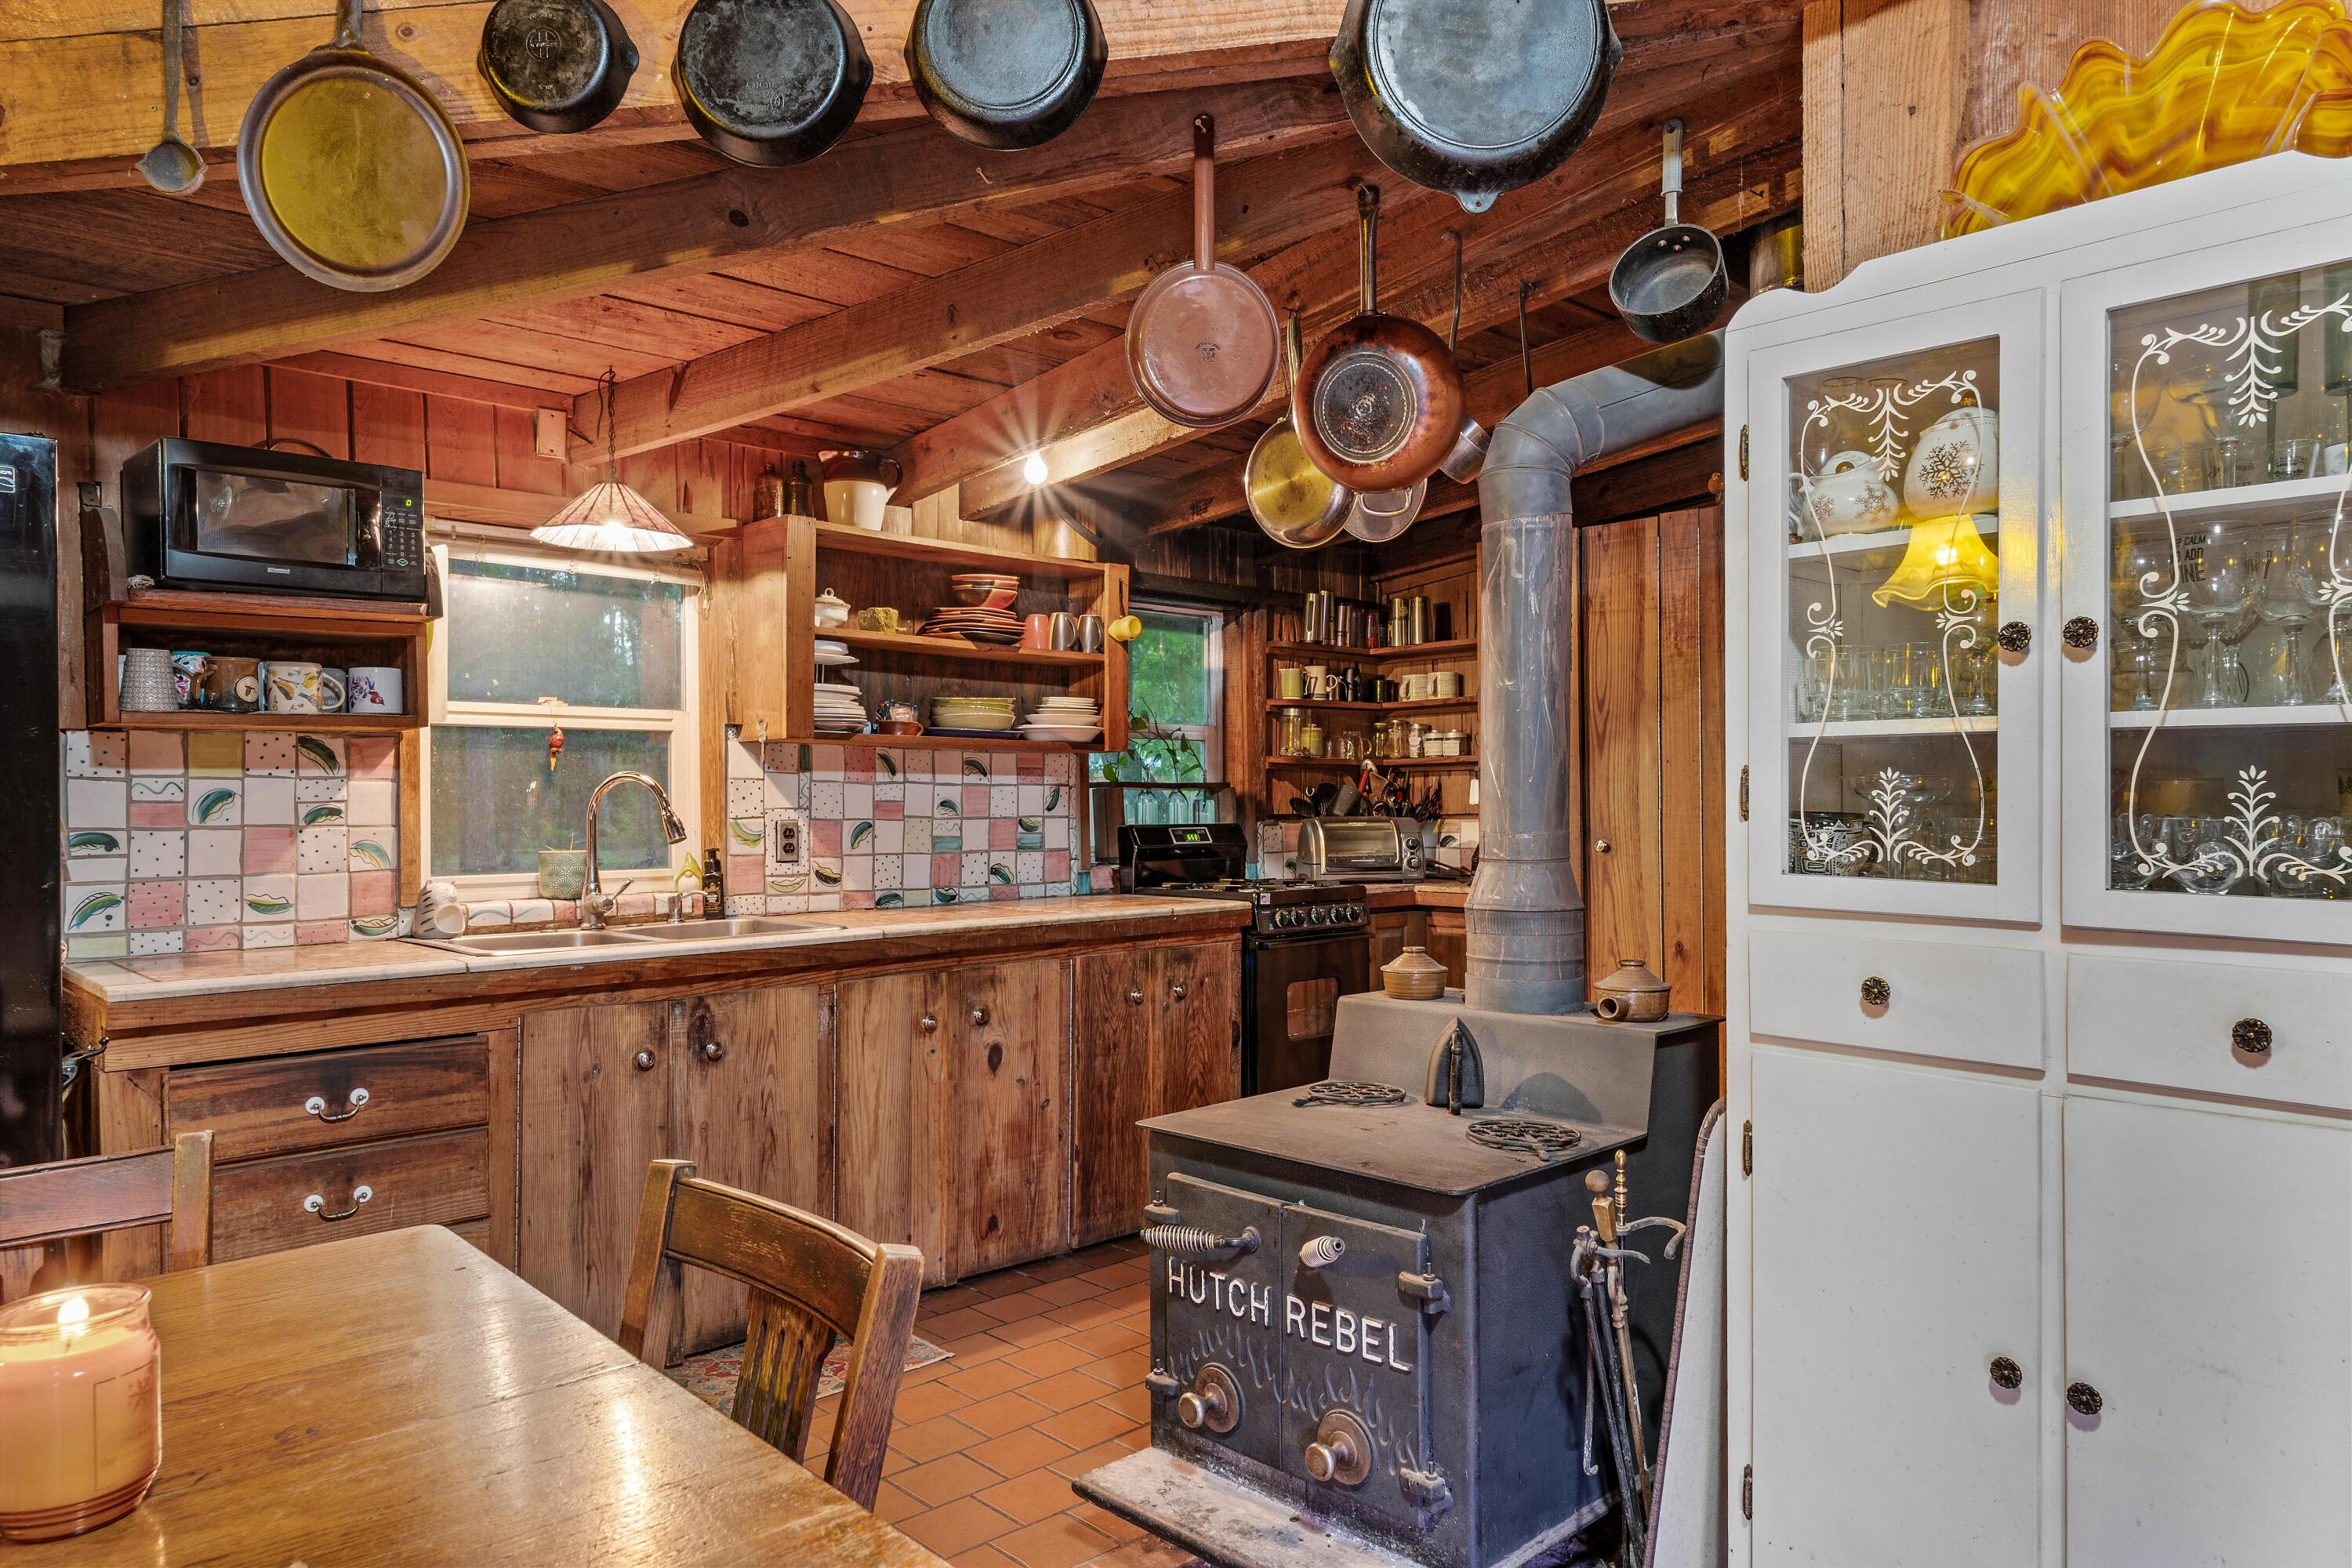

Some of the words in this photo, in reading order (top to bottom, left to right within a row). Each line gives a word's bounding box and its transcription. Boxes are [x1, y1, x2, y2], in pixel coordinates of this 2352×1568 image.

[2184, 534, 2207, 546] CALM
[2184, 547, 2204, 561] ADD
[1168, 1255, 1272, 1327] HUTCH
[1287, 1293, 1414, 1371] REBEL
